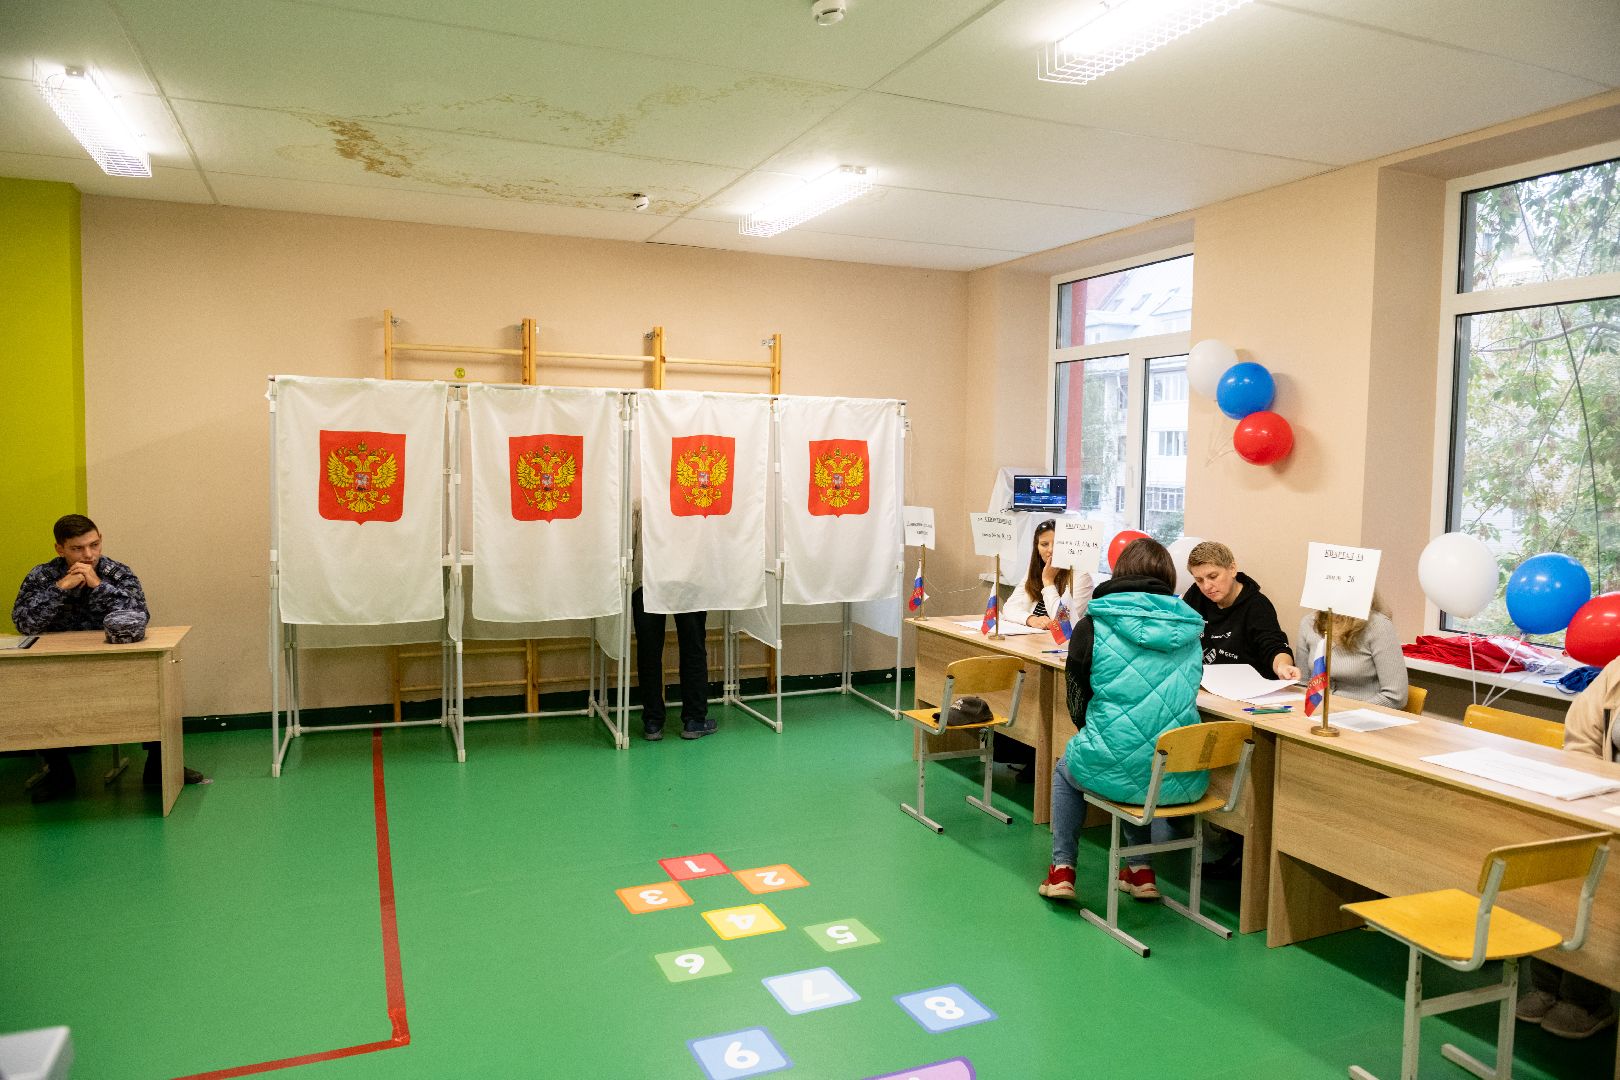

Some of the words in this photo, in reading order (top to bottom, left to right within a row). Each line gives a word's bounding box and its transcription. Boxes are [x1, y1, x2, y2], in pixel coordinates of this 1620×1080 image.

[685, 861, 706, 873] 1
[756, 871, 785, 887] 2
[639, 889, 668, 905] 3
[727, 913, 756, 930] 4
[826, 925, 857, 944] 5
[674, 953, 705, 974] 6
[802, 979, 829, 1003] 7
[924, 996, 965, 1020] 8
[724, 1041, 760, 1070] 9
